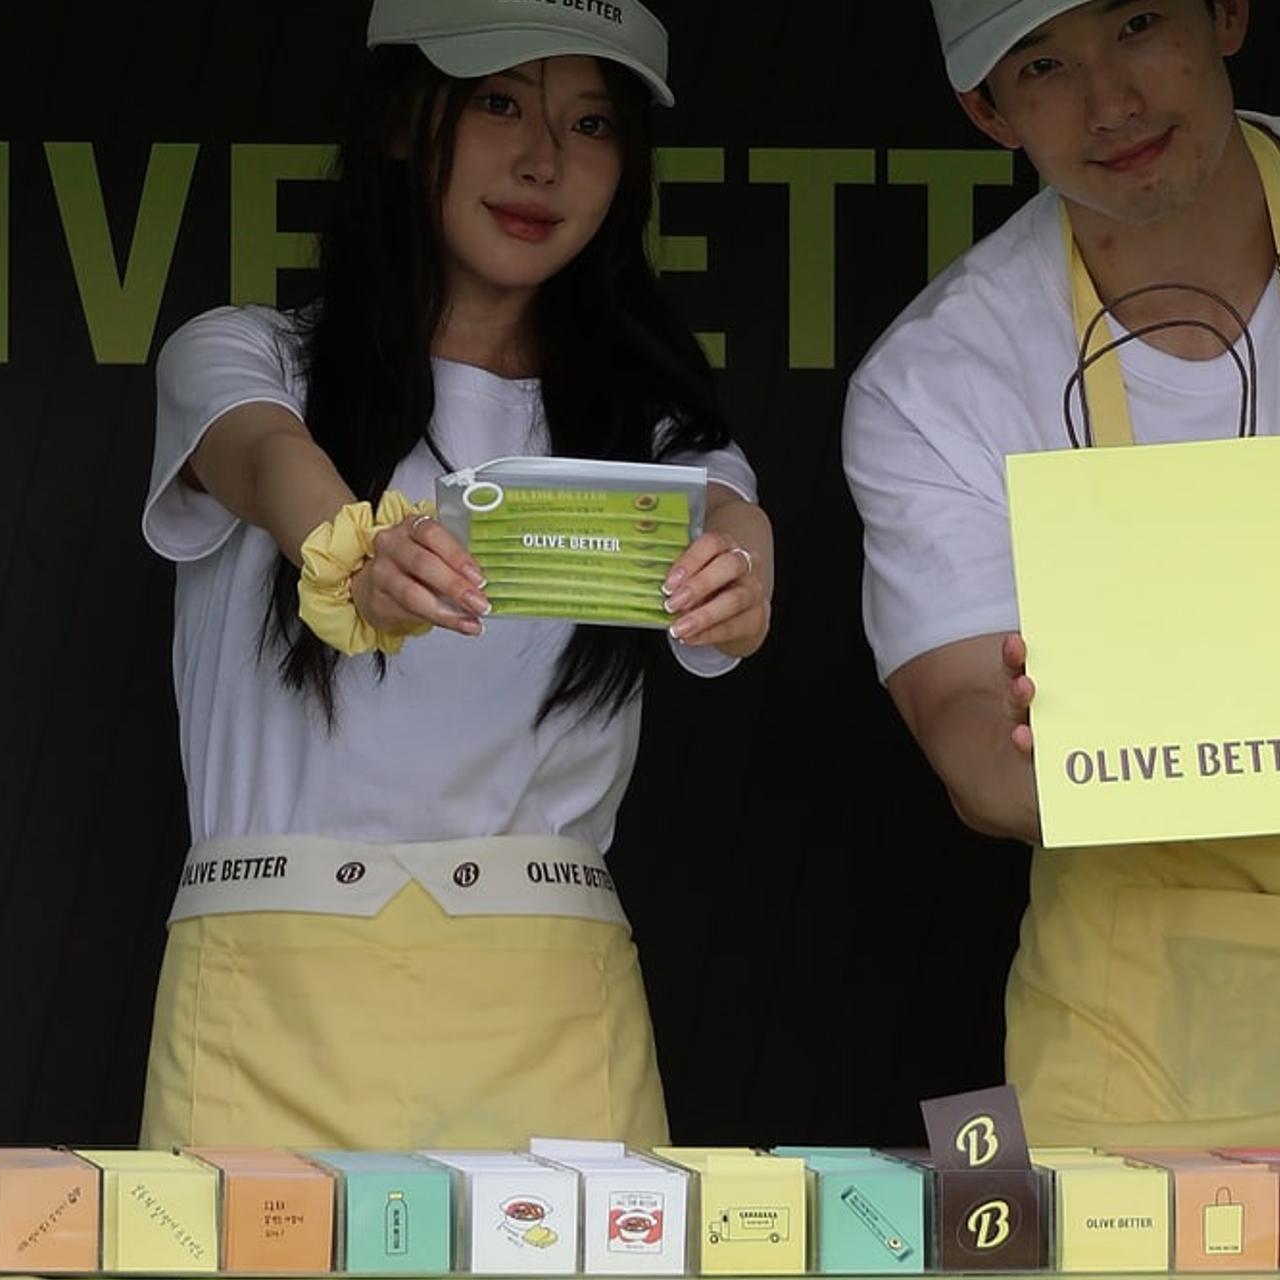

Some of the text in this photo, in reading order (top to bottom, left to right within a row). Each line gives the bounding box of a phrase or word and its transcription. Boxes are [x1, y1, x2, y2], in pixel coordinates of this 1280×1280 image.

[523, 534, 621, 552] OLIVE BETTER
[1065, 745, 1183, 784] OLIVE
[221, 856, 288, 883] BETTER
[527, 862, 582, 885] OLIVE
[968, 1201, 1009, 1248] B
[1086, 1217, 1153, 1229] OLIVE BETTER
